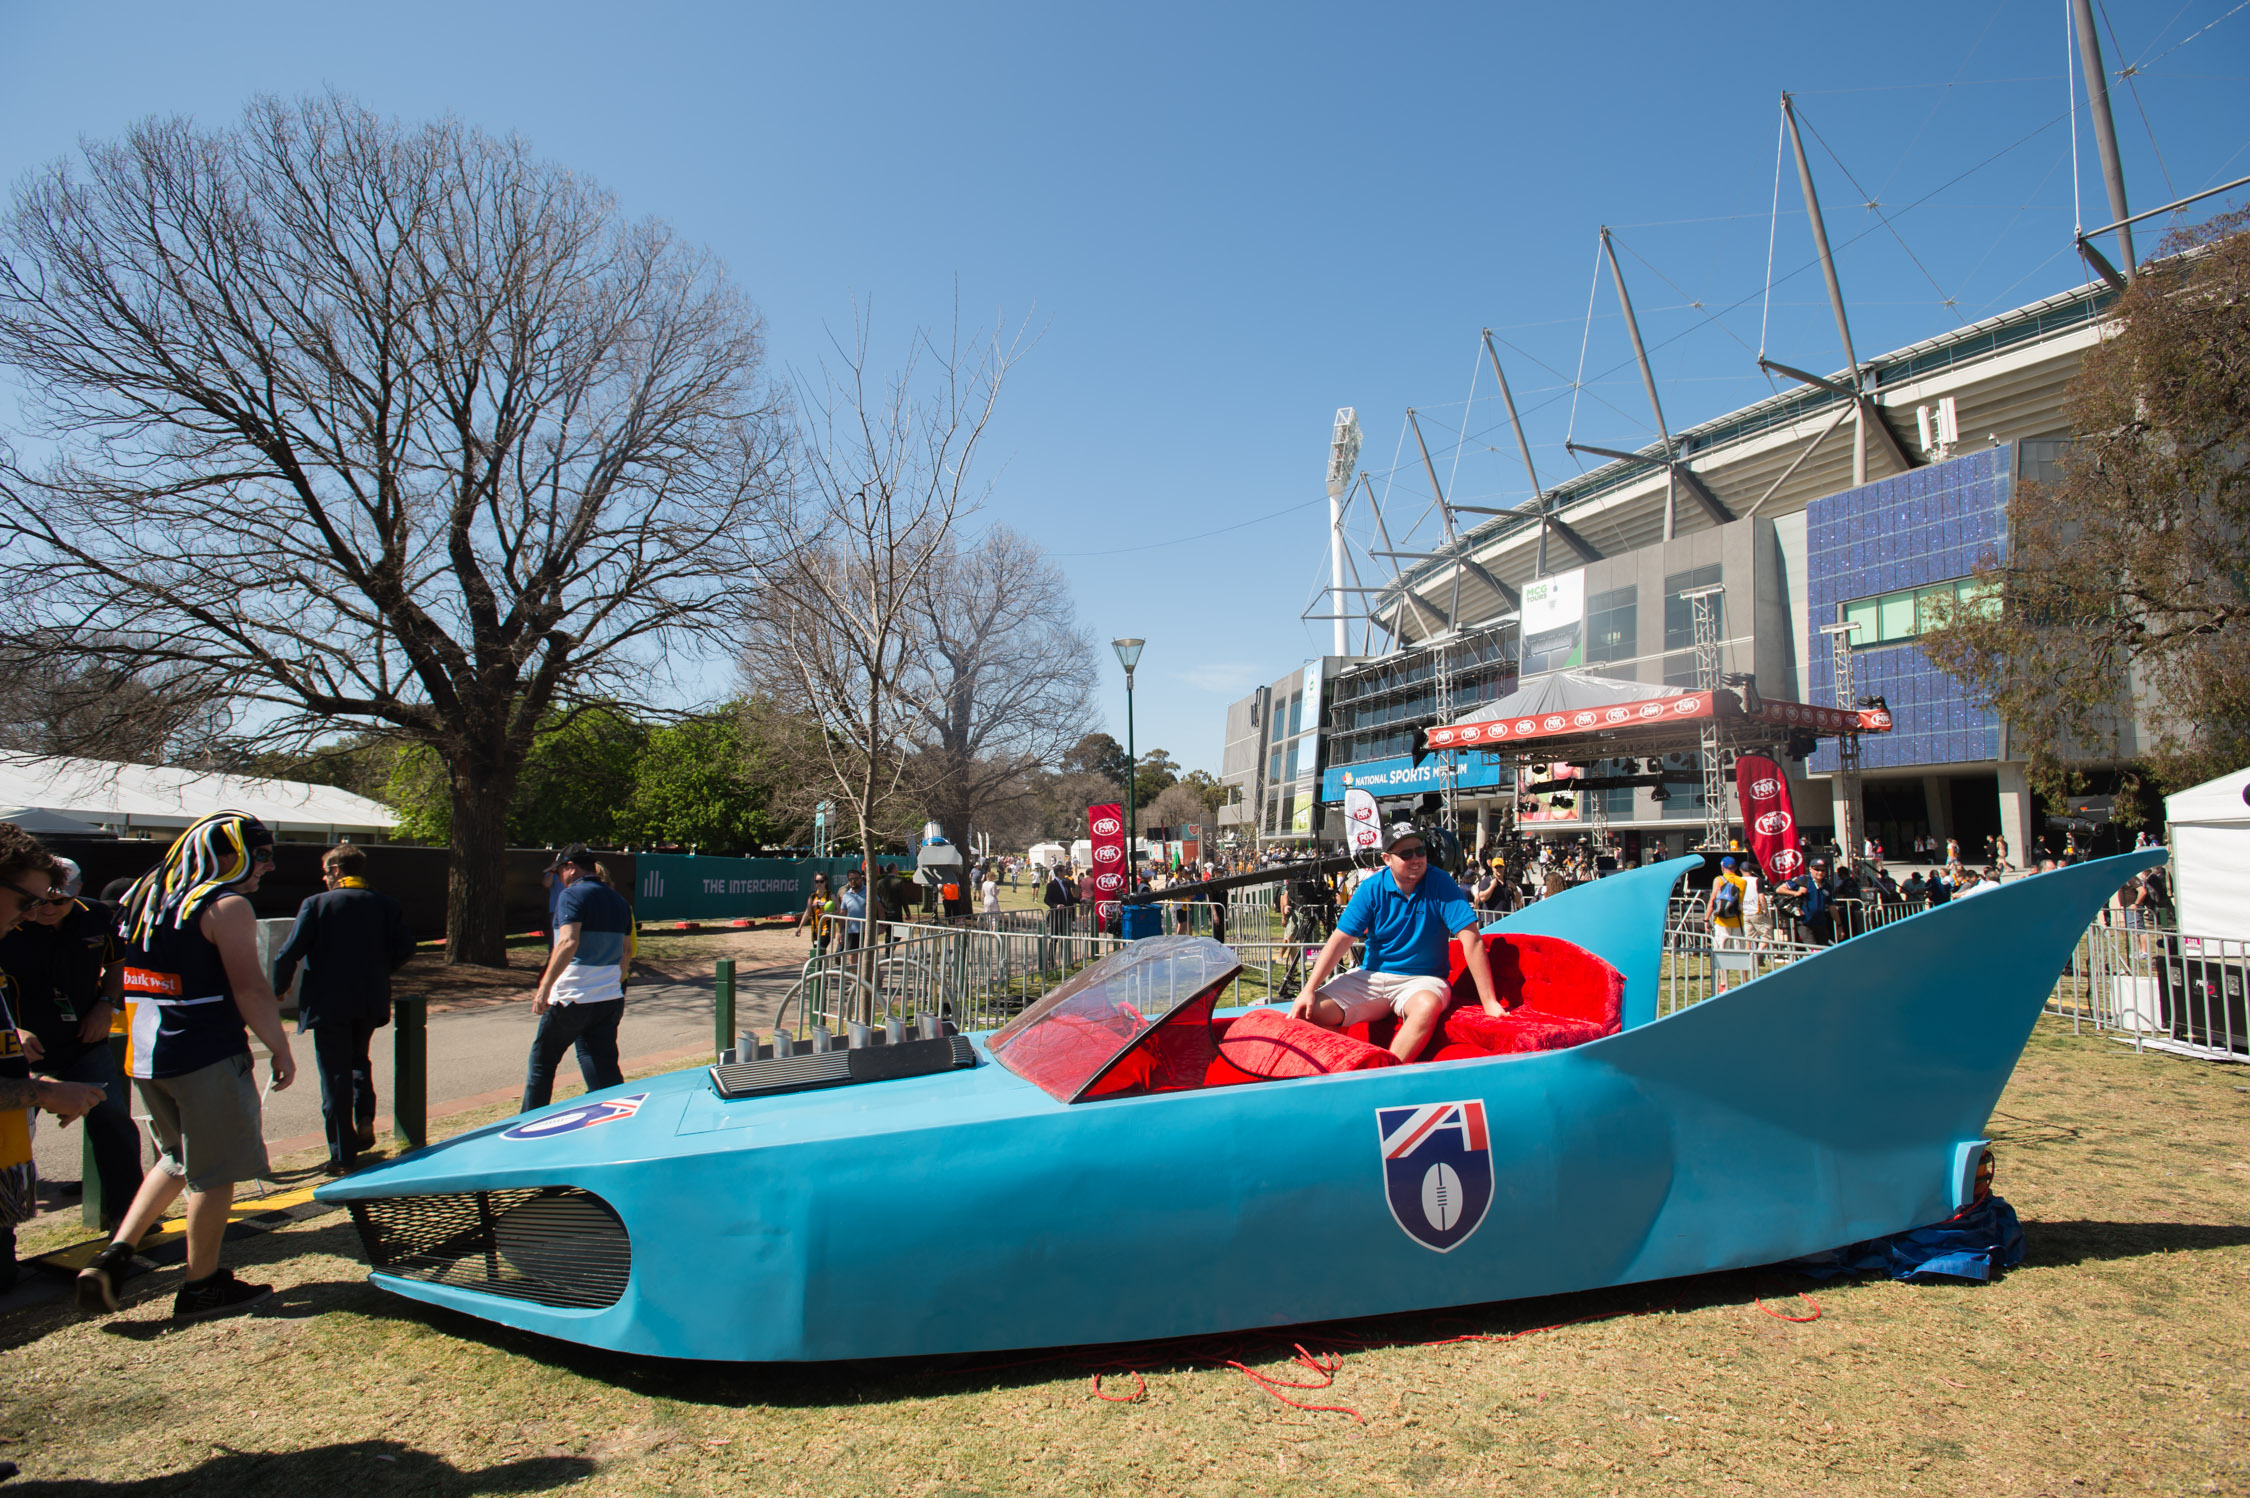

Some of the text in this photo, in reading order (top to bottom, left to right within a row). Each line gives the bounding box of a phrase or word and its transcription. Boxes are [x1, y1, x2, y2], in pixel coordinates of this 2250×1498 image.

[1526, 584, 1548, 597] MCG
[1527, 593, 1547, 603] TOURS
[1355, 763, 1468, 786] NATIONAL SPORTS MUM
[1754, 781, 1775, 794] FOX
[1356, 808, 1371, 818] FOX
[1098, 822, 1115, 831] FOX
[1460, 821, 1475, 832] Gate
[1761, 814, 1785, 829] FOX
[1206, 832, 1213, 843] 3
[1359, 832, 1375, 843] FOX
[1100, 849, 1116, 858] FOX
[1774, 852, 1795, 867] FOX
[702, 878, 800, 894] THE INTERCHANGE
[1101, 877, 1118, 886] FOX
[123, 971, 177, 991] bakwst
